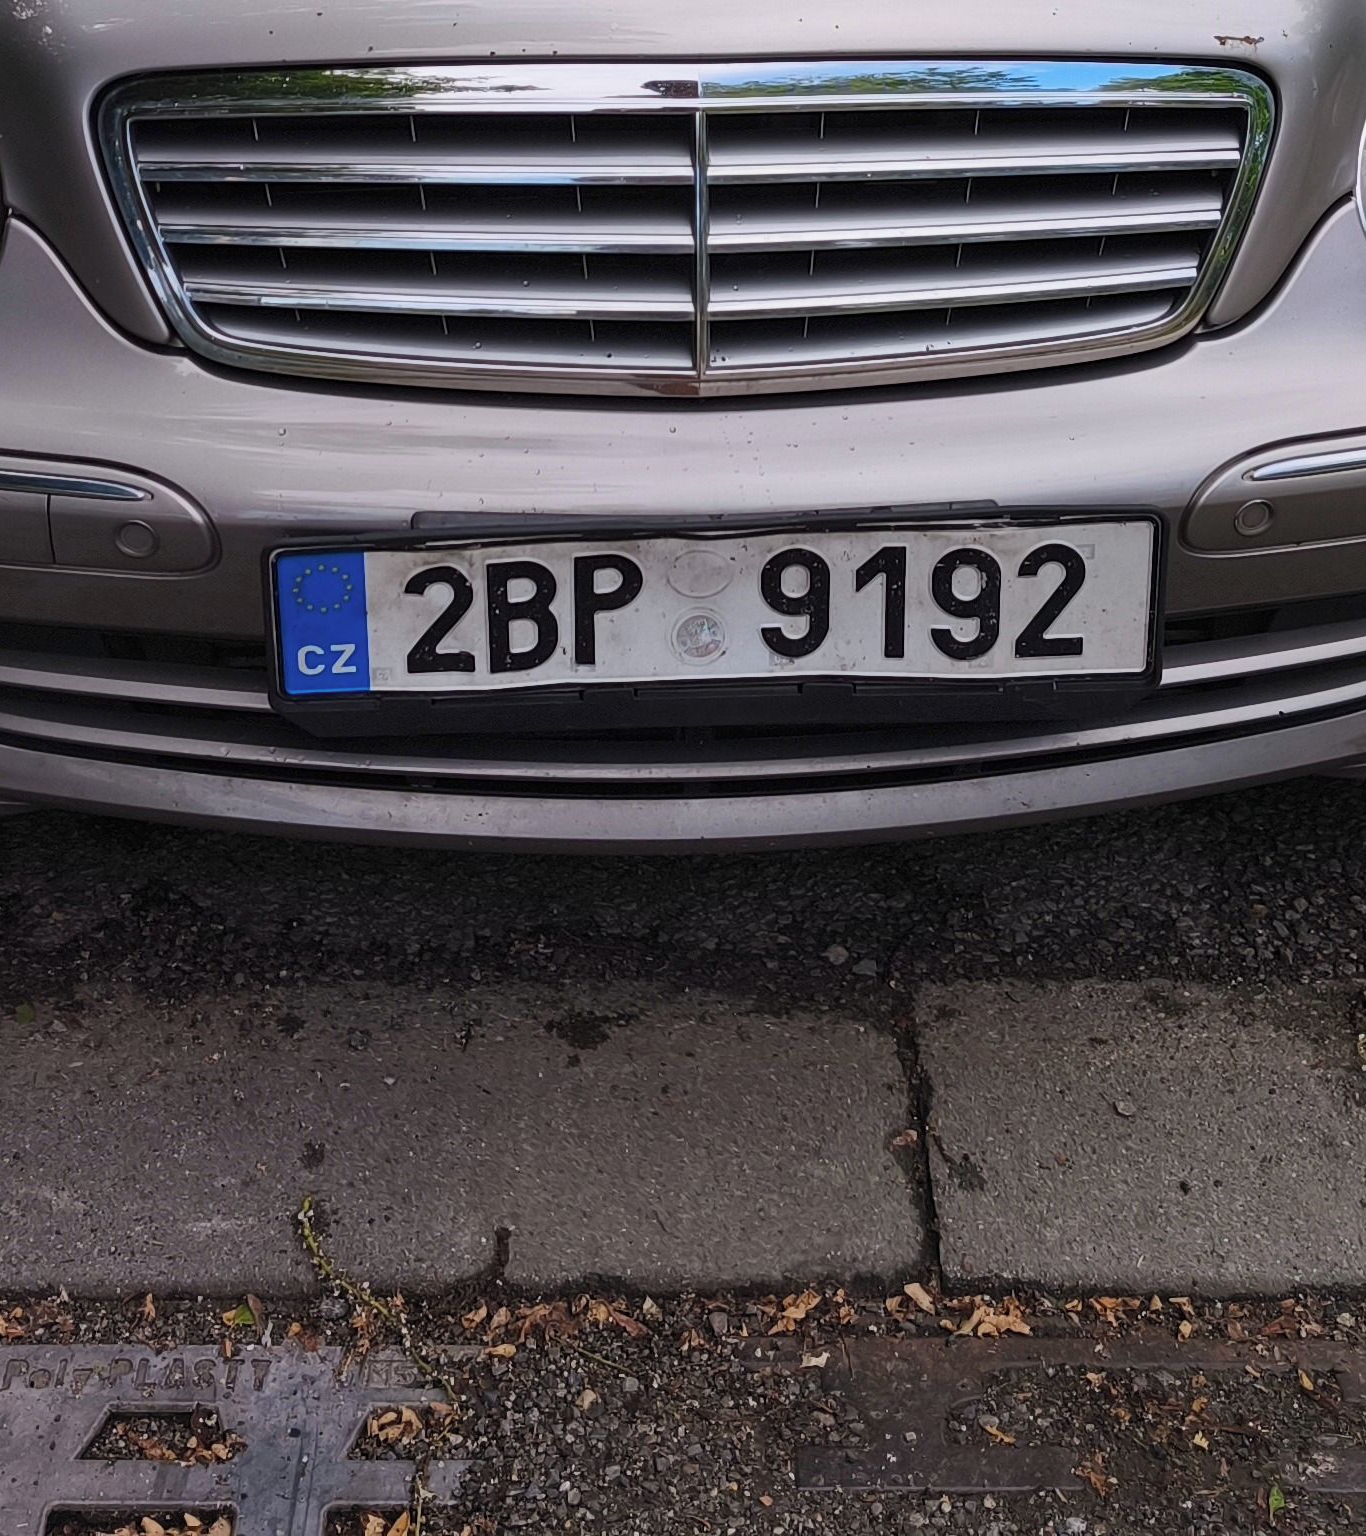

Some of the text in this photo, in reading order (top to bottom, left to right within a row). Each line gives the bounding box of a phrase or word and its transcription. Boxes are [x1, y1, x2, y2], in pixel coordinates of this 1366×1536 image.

[403, 542, 1086, 675] 2BP 9192
[296, 643, 357, 677] CZ
